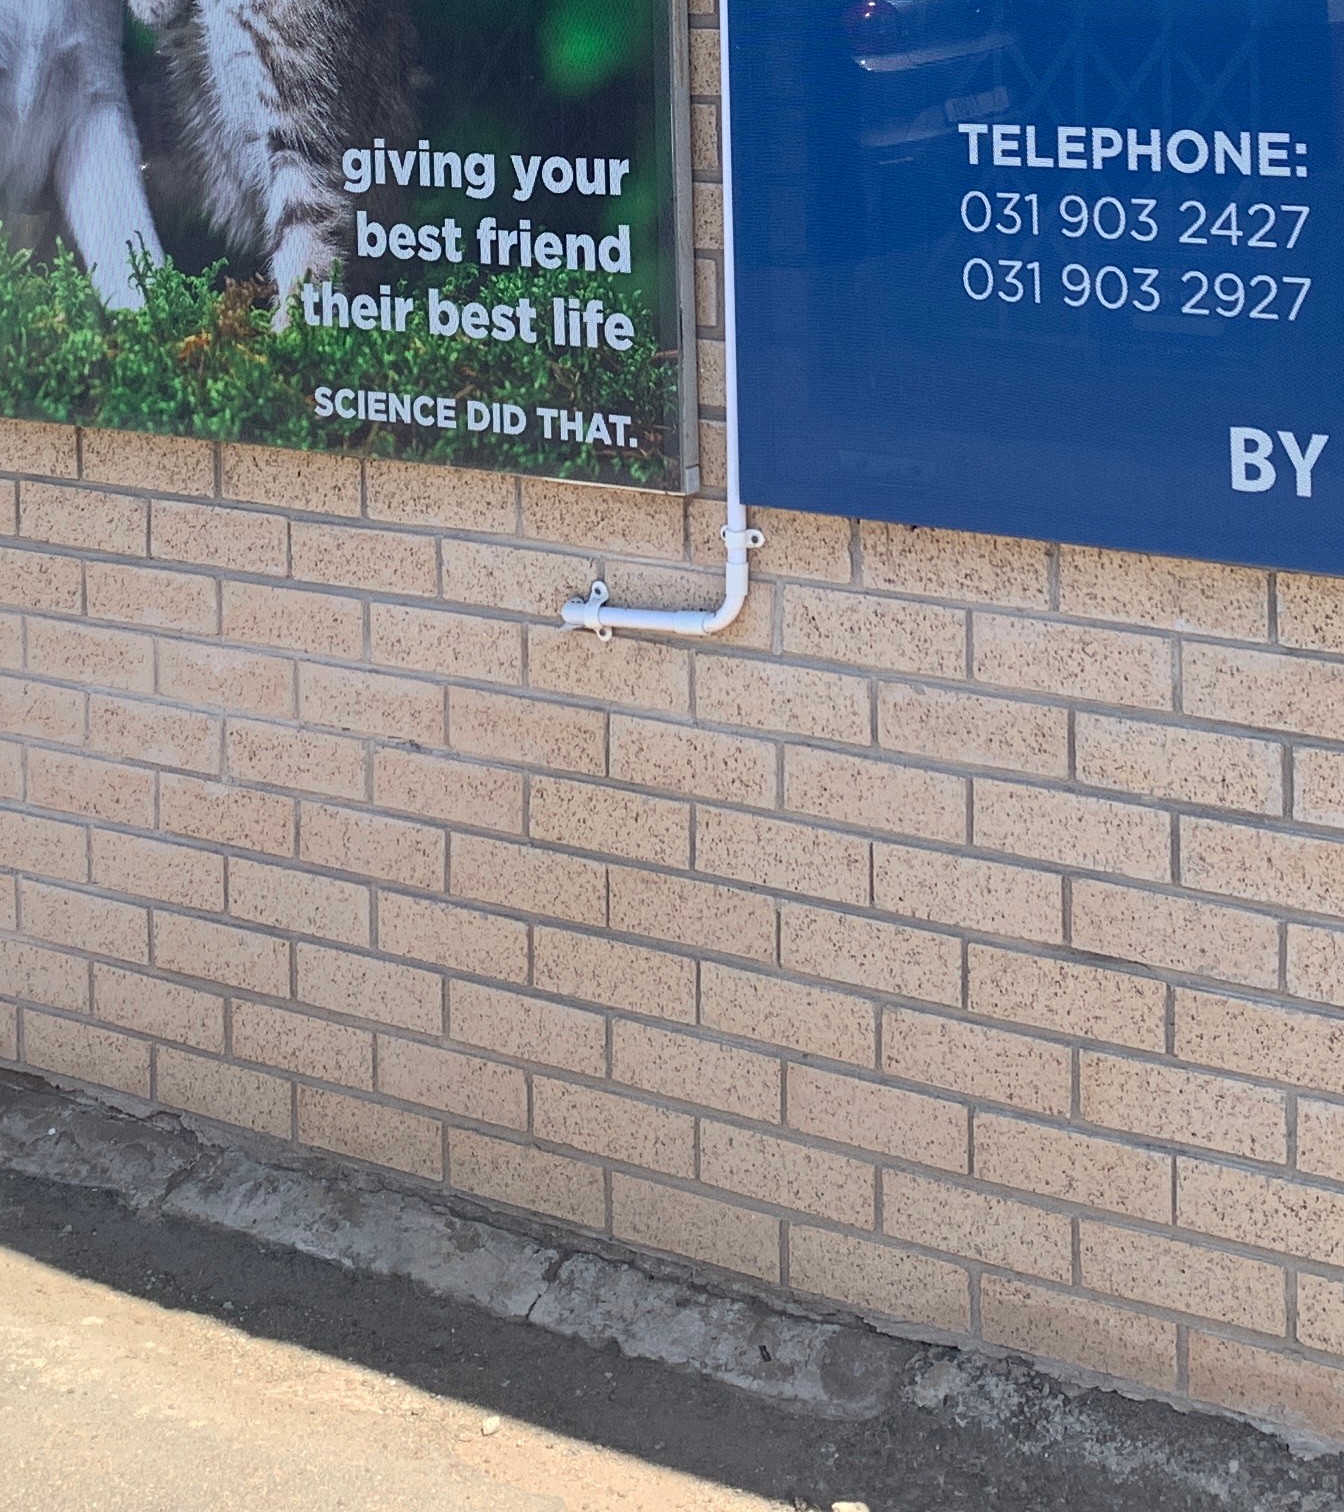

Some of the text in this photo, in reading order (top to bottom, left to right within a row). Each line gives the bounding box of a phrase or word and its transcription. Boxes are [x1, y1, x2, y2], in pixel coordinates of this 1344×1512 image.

[341, 136, 630, 202] giving your
[959, 124, 1306, 176] TELEPHONE:
[356, 212, 632, 274] best friend
[962, 192, 1308, 247] 031 903 2427
[301, 283, 635, 351] their best life
[964, 259, 1310, 319] 031 903 2927
[314, 386, 638, 449] SCIENCE DID THAT.
[1231, 428, 1328, 496] BY
